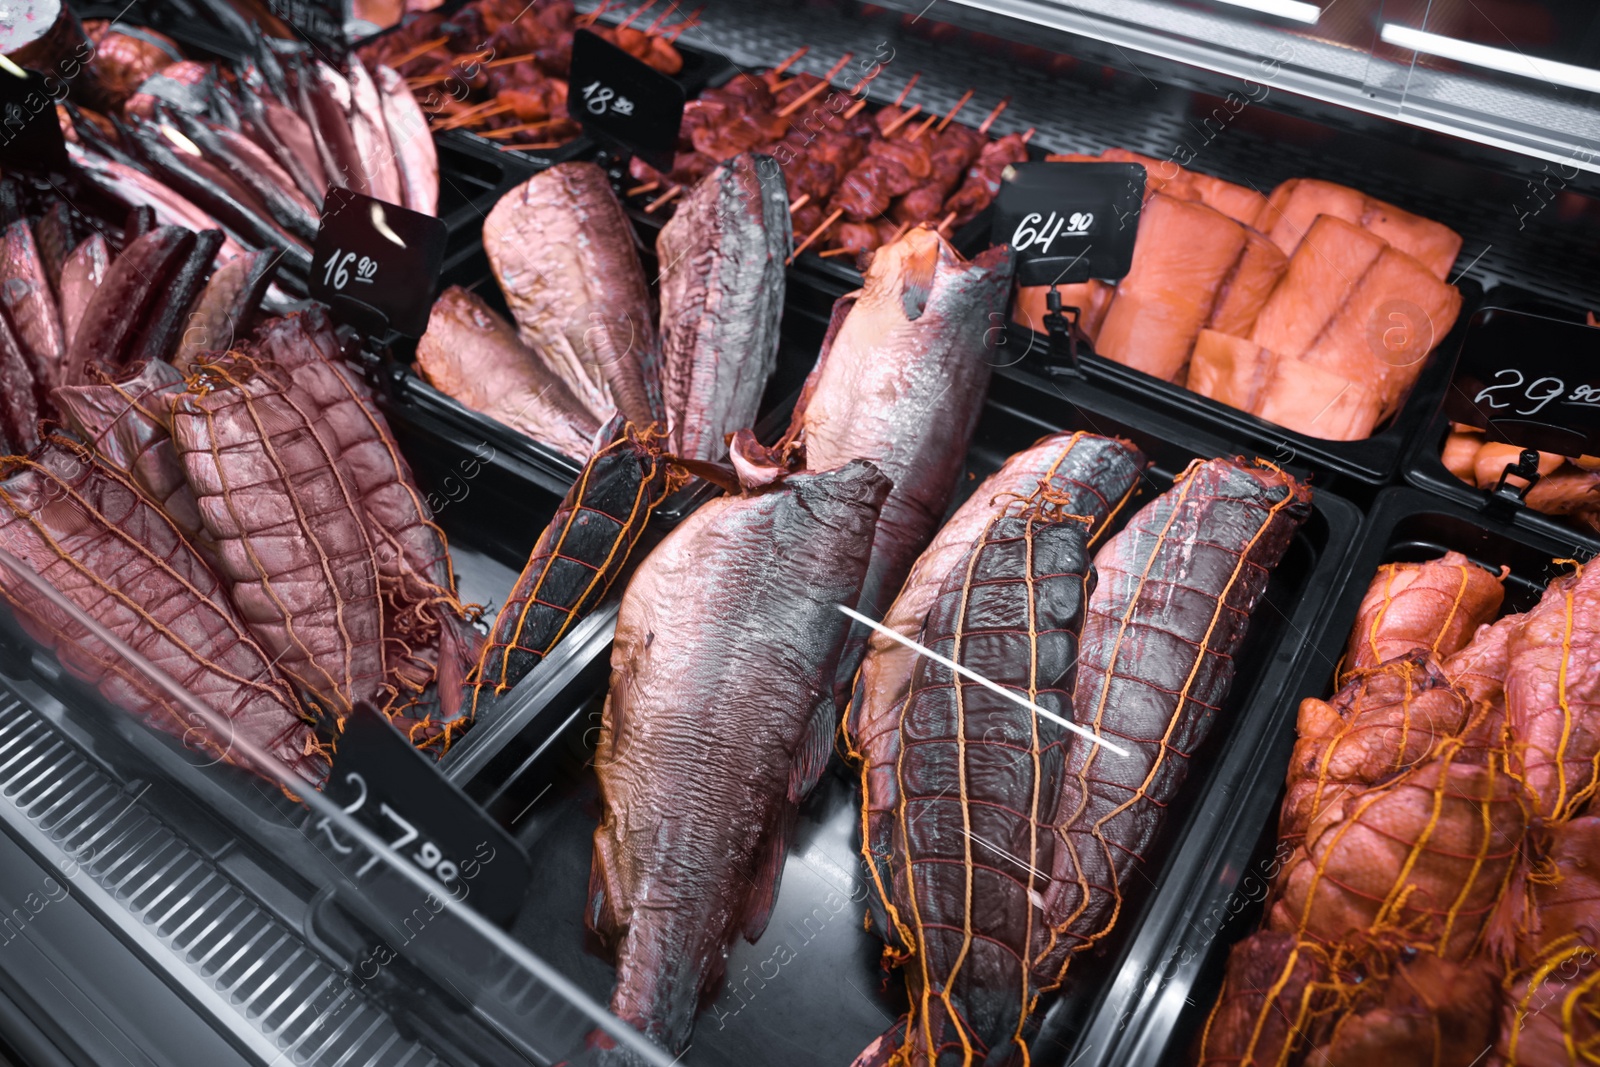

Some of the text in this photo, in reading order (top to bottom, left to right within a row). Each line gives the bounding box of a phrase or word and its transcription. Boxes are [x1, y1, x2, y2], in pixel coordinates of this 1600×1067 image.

[582, 81, 615, 115] 18
[1011, 211, 1065, 254] 64
[323, 248, 357, 290] 16
[1474, 369, 1565, 415] 29
[413, 842, 459, 882] 90
